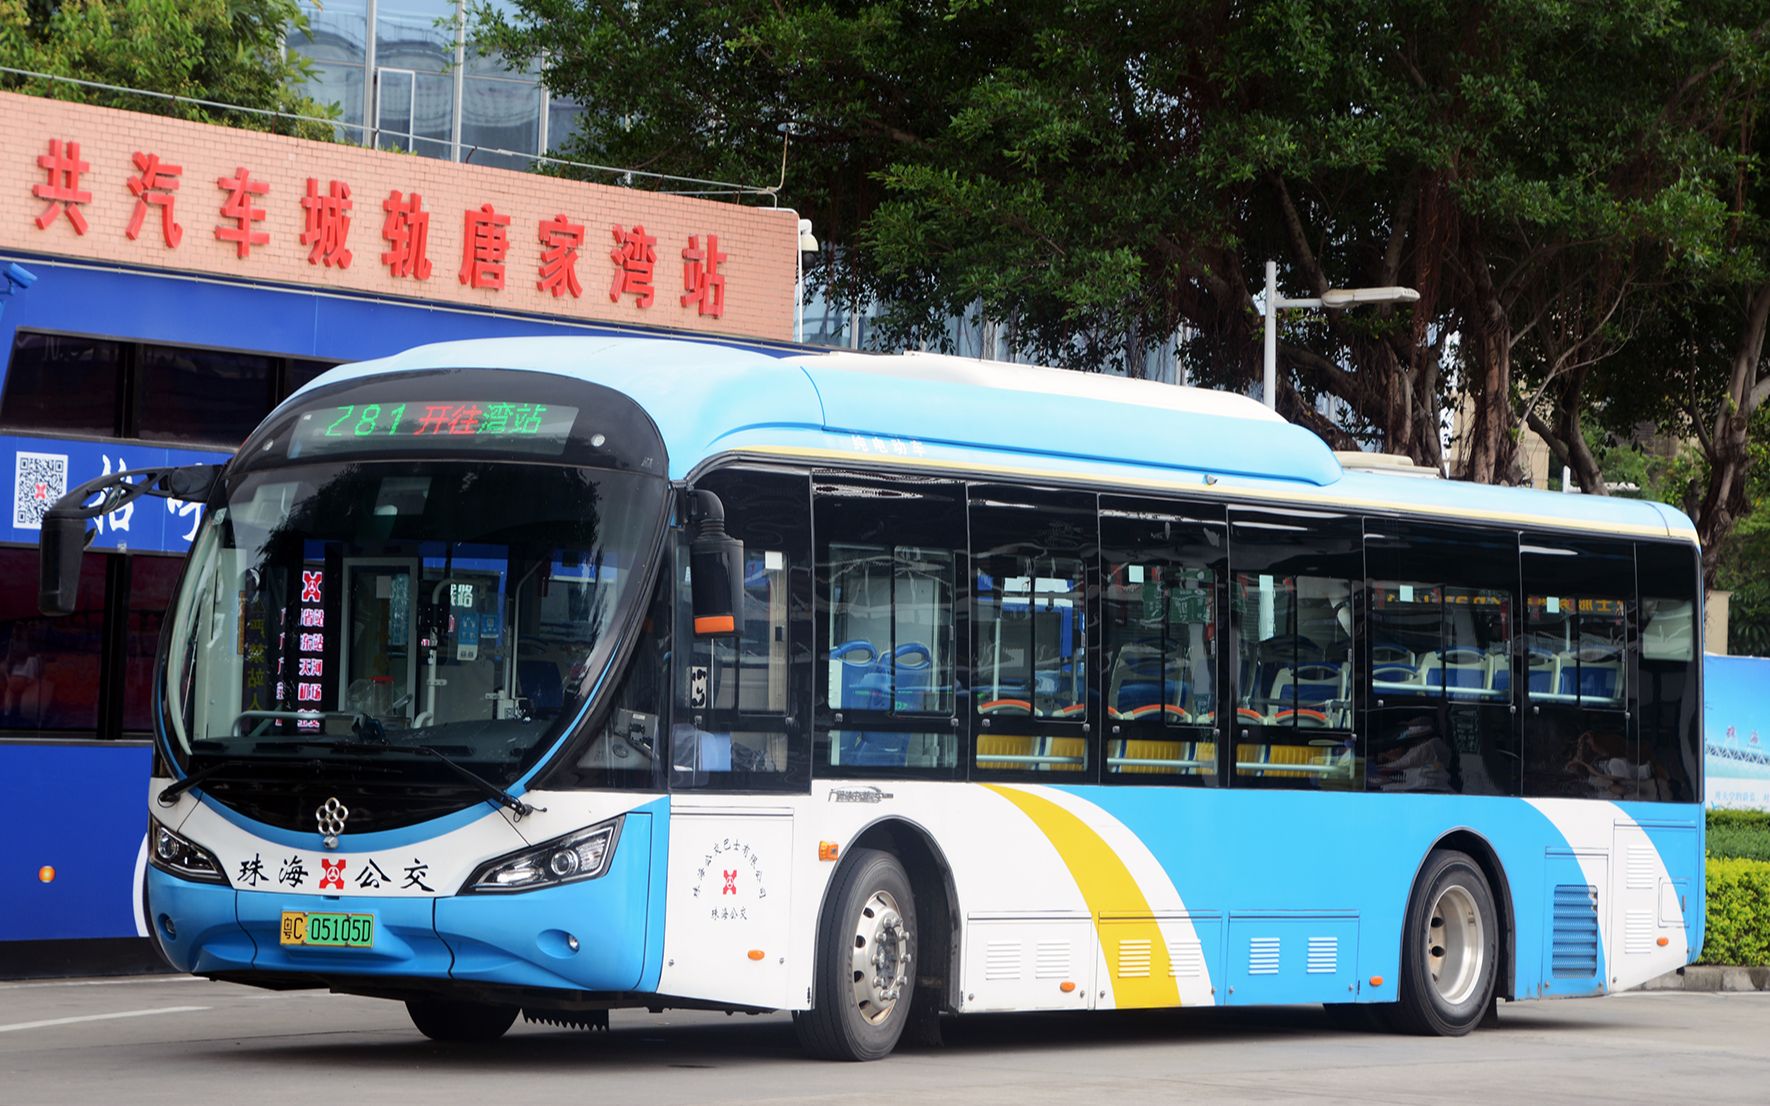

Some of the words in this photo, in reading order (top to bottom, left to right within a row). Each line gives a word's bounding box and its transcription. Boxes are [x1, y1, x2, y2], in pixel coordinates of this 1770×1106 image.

[33, 138, 728, 320] 共汽车城轨唐家湾站
[237, 853, 309, 887] 珠海
[355, 858, 435, 892] 公交
